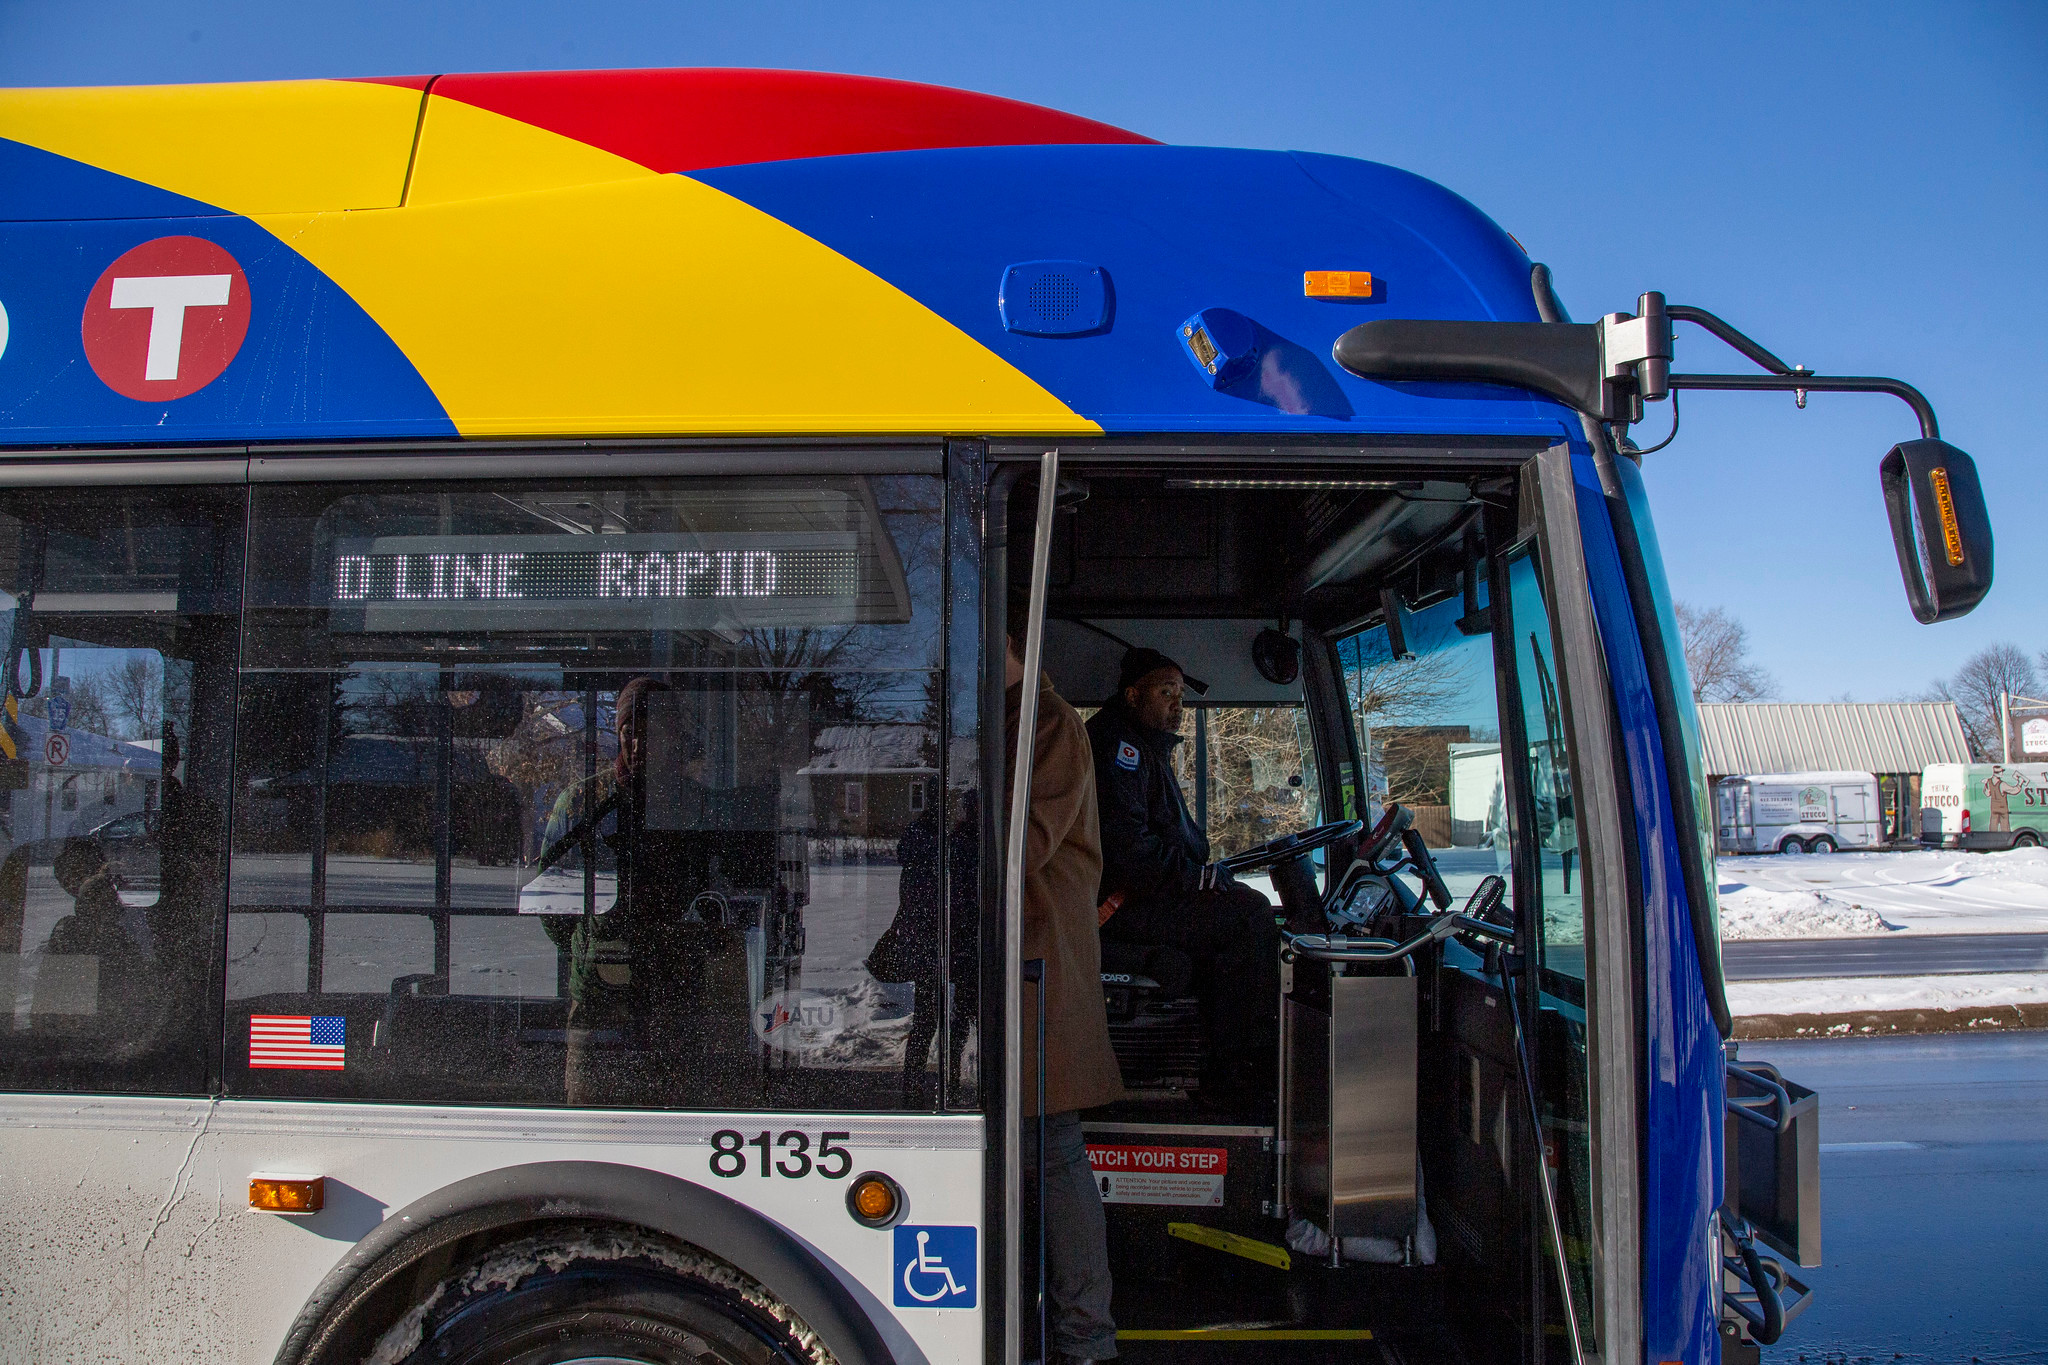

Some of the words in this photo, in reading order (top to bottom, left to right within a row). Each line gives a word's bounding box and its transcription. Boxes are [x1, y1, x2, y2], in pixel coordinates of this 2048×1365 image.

[109, 274, 232, 381] T
[338, 554, 371, 599] D
[396, 553, 525, 598] LINE
[599, 551, 776, 597] RAPID
[1924, 795, 1959, 807] STUCCO
[788, 1006, 834, 1027] ATU
[709, 1129, 853, 1180] 8135
[1086, 1150, 1127, 1166] ATCH
[1132, 1151, 1175, 1168] YOUR
[1180, 1153, 1219, 1169] STEP
